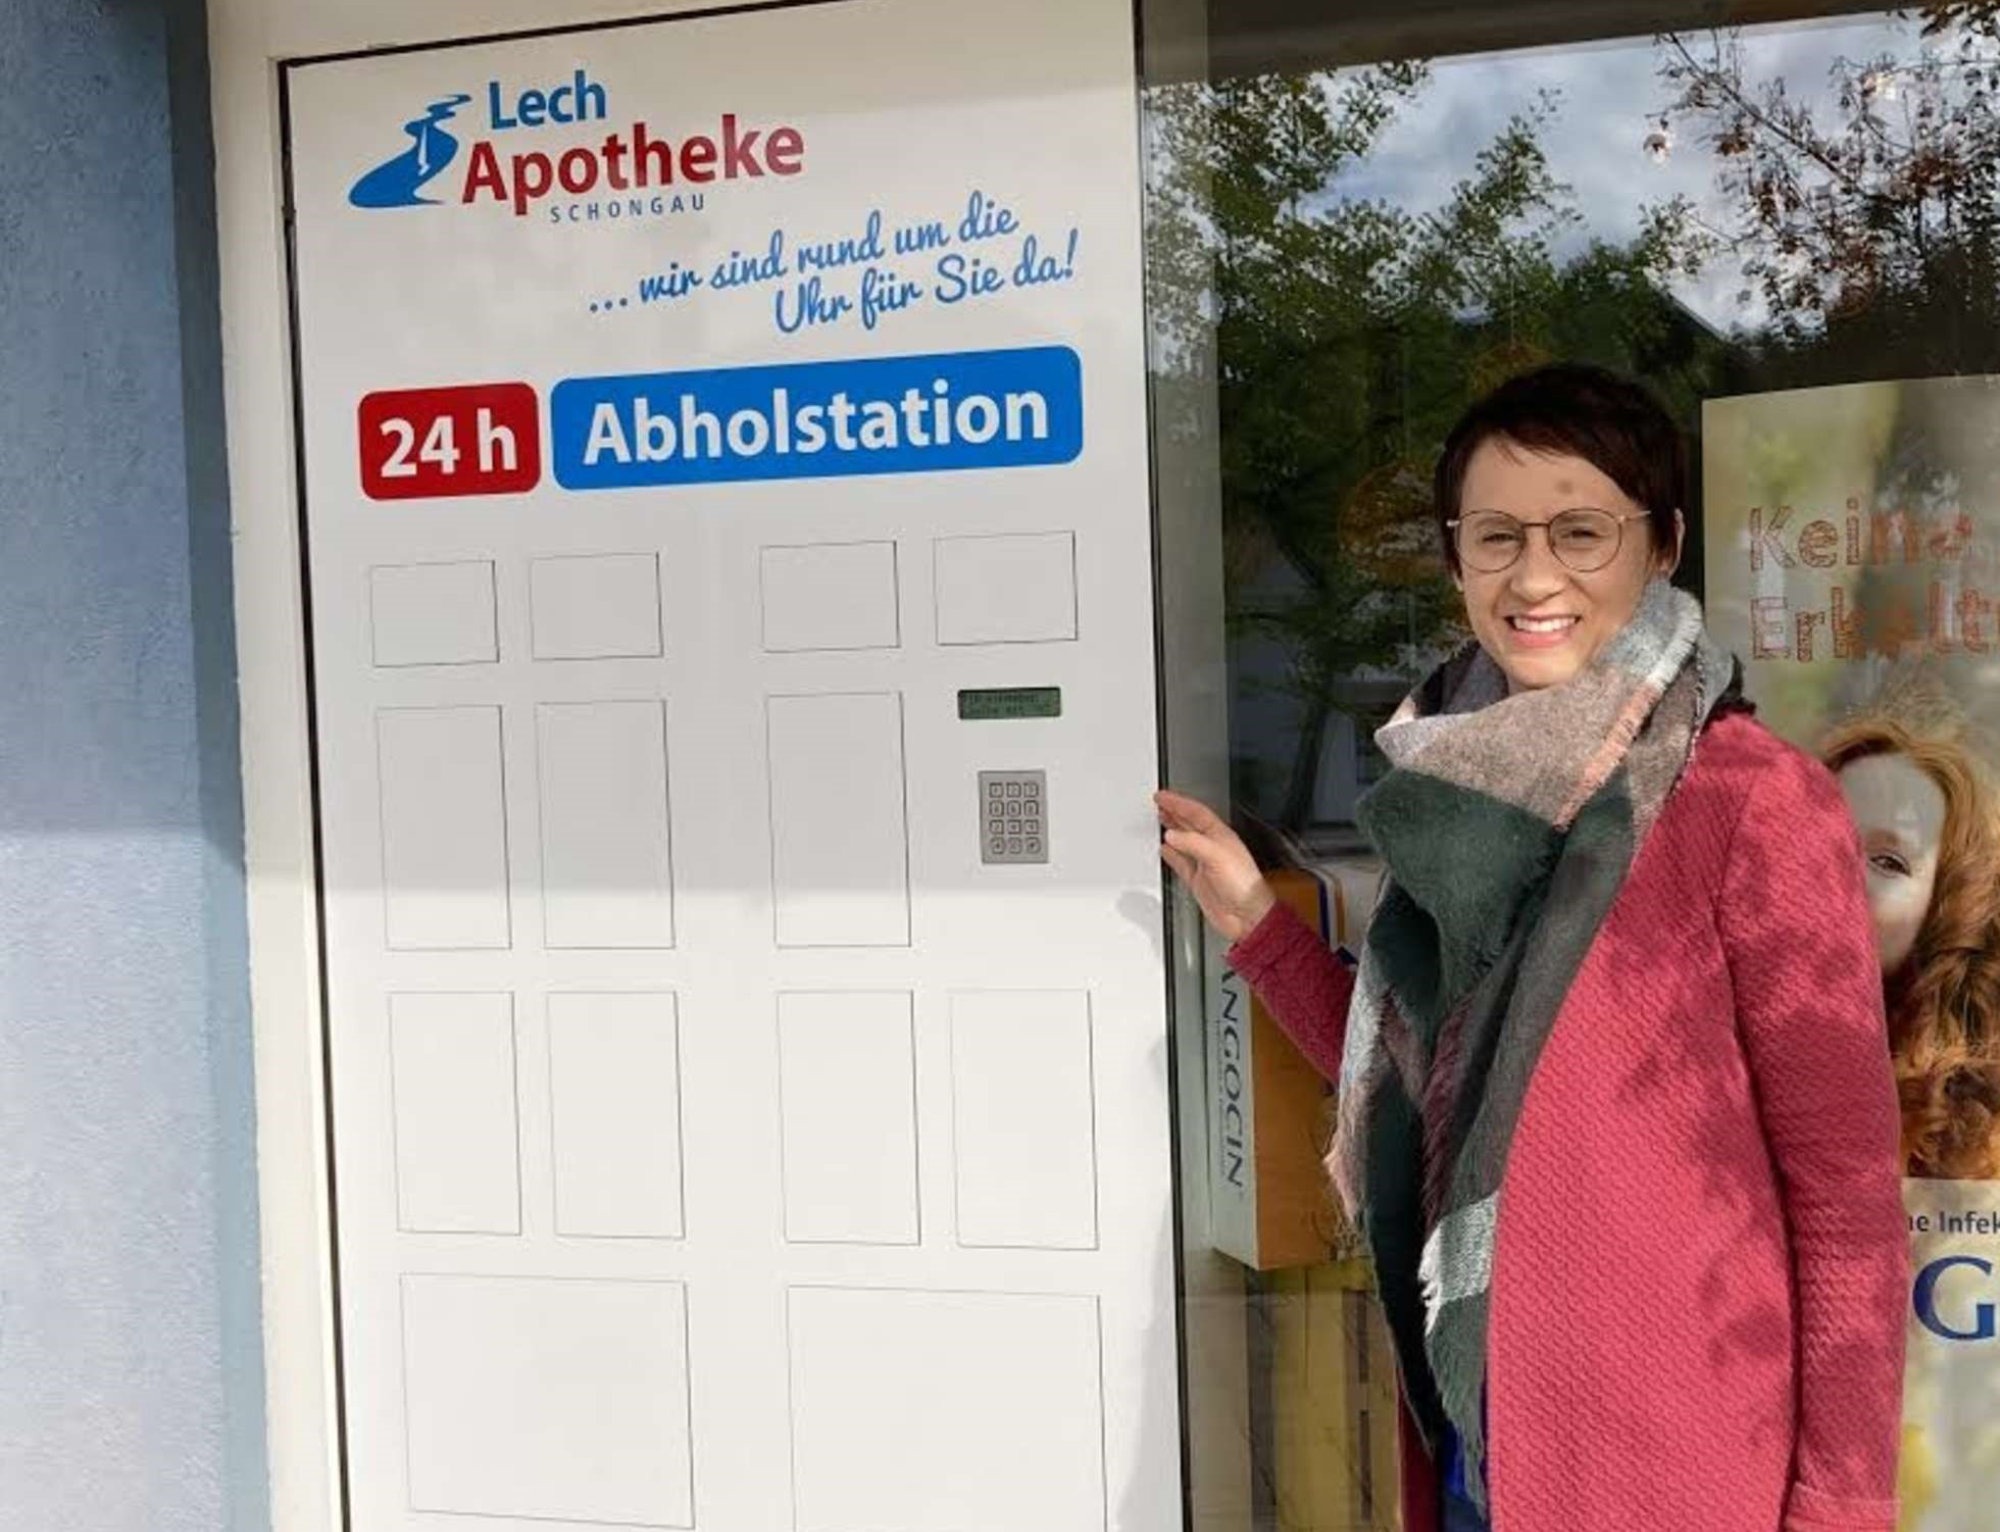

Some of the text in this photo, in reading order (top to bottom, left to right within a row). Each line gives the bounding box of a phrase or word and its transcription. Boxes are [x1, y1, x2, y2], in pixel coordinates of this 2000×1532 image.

[489, 71, 606, 130] Lech
[462, 113, 804, 216] Apotheke
[549, 193, 706, 223] SCHONGAU
[639, 262, 702, 303] wir
[709, 230, 788, 290] sind
[797, 209, 887, 273] rund
[894, 224, 951, 254] um
[957, 189, 1021, 241] die
[775, 228, 1079, 333] Uhr für Sie da!
[383, 404, 517, 477] 24 h
[583, 379, 1048, 465] Abholstation
